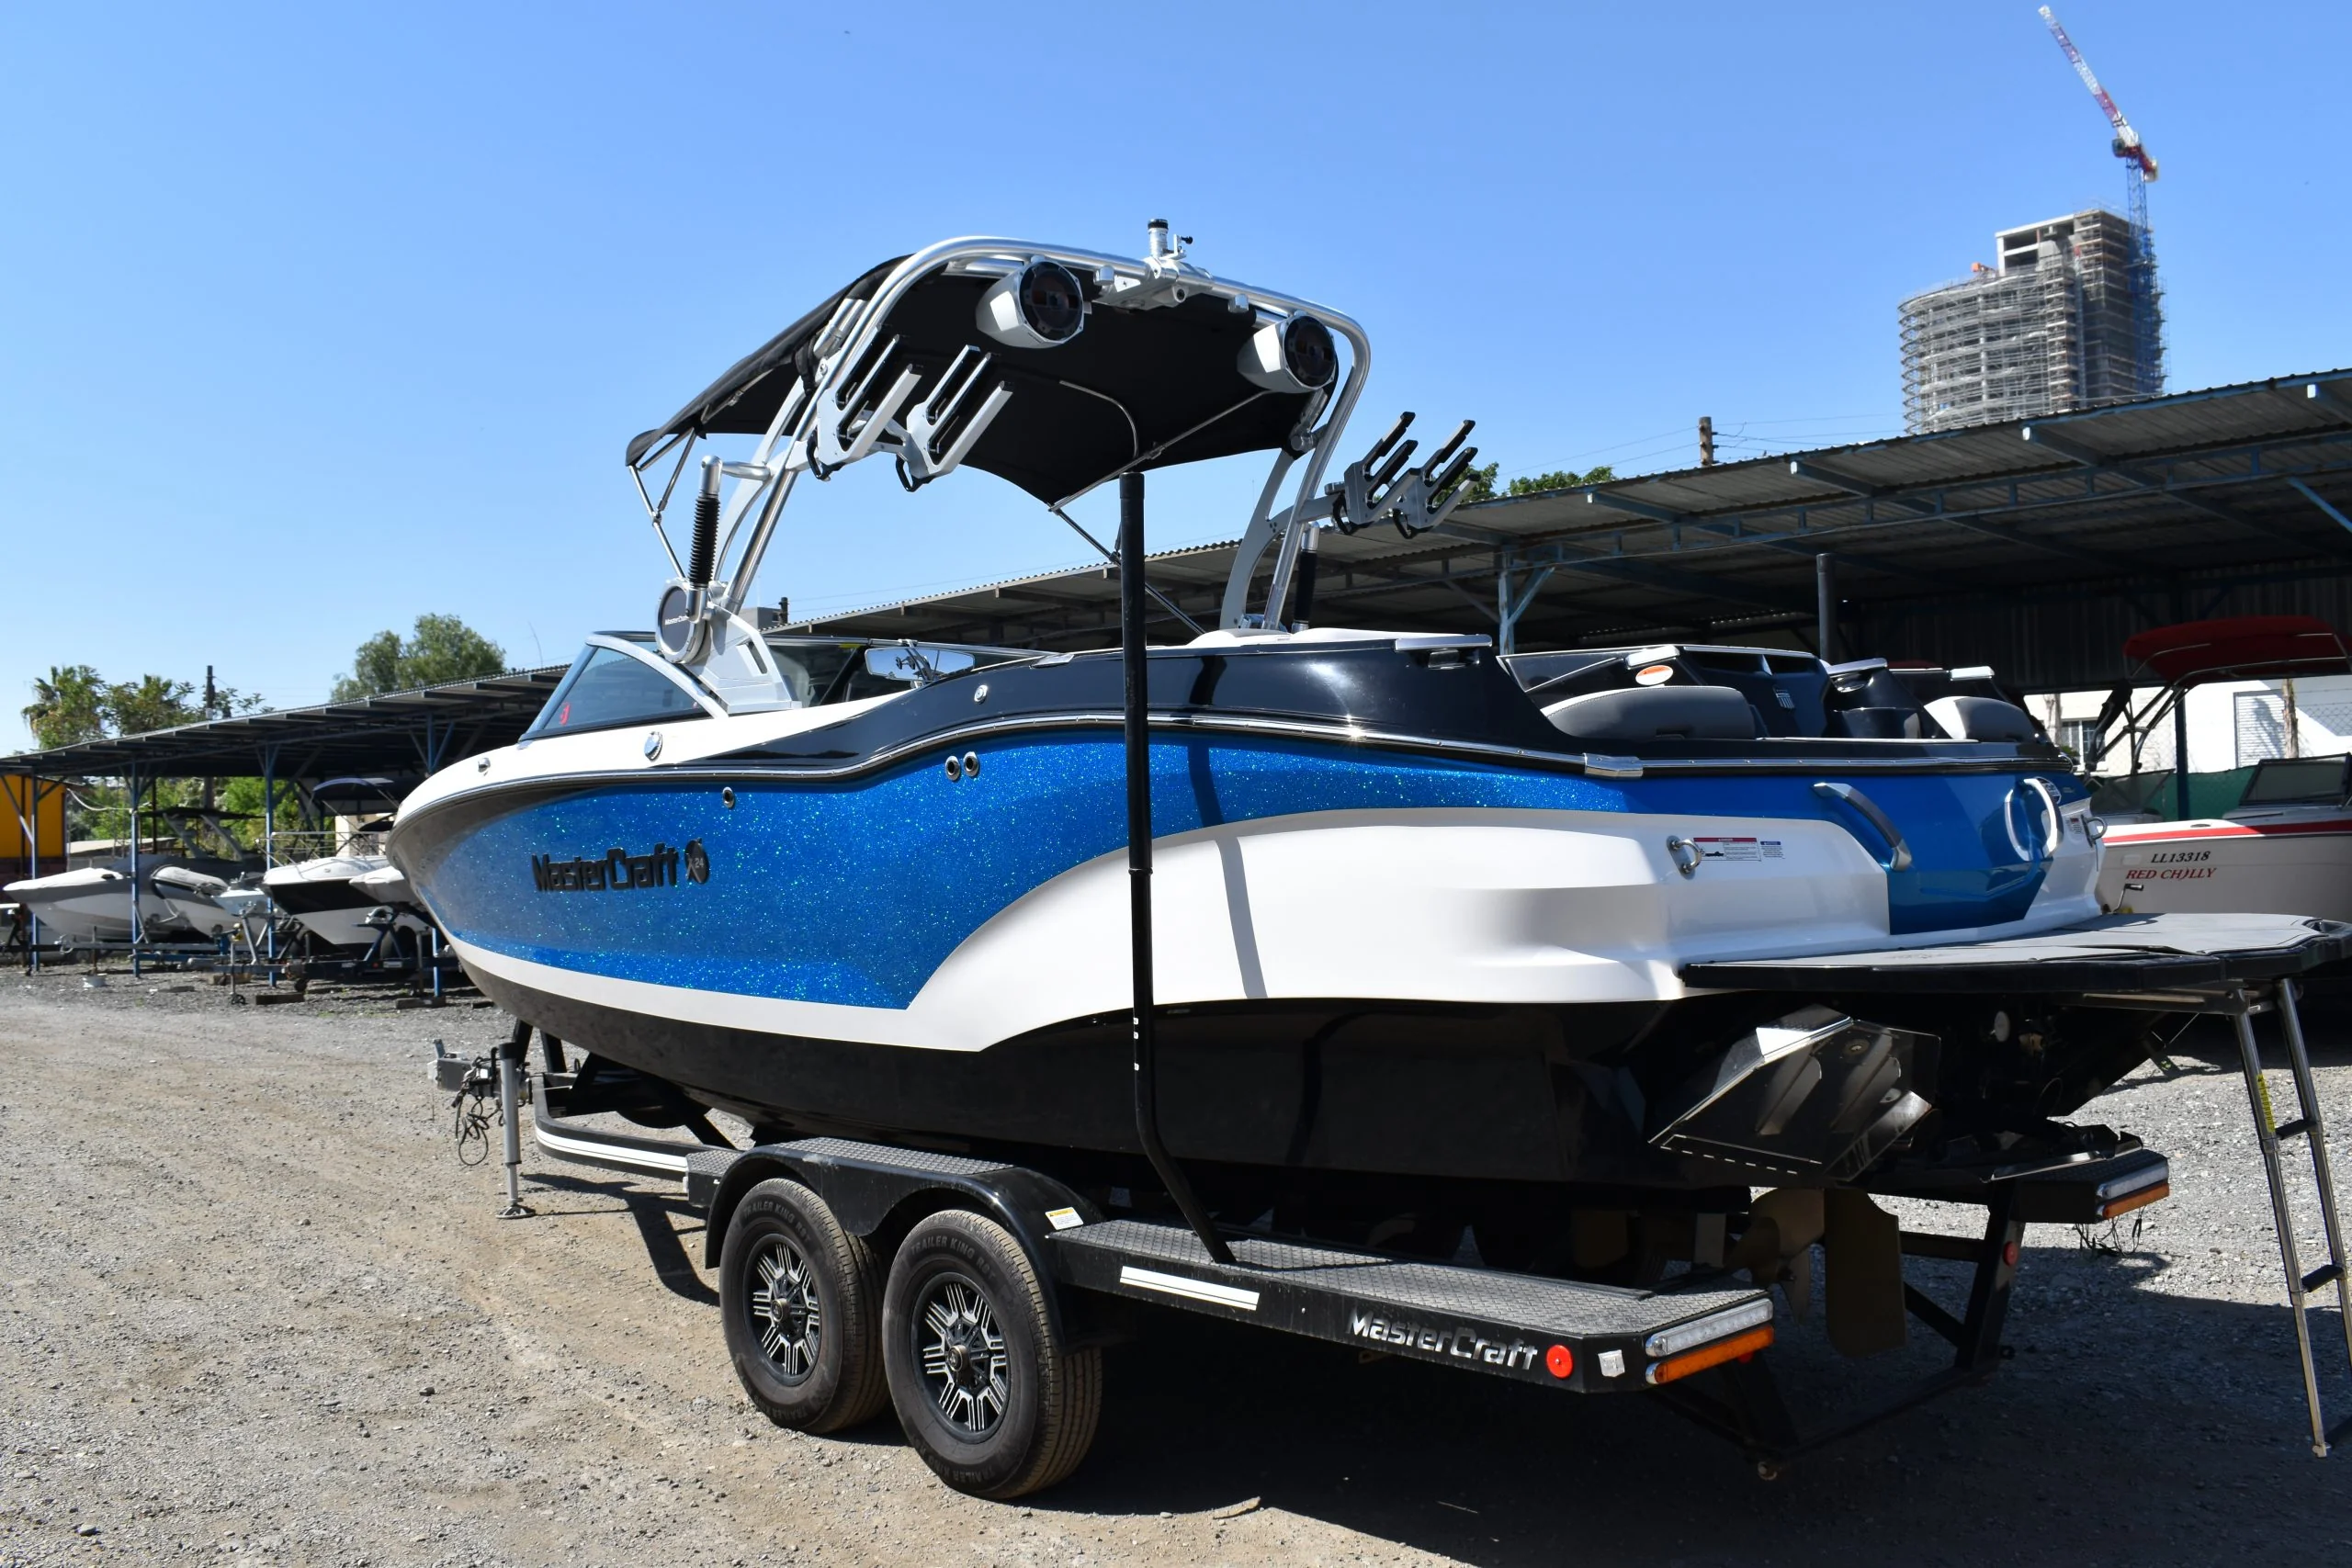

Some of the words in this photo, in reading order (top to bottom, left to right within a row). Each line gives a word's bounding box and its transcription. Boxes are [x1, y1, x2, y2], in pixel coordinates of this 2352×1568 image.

[531, 841, 679, 892] MasterCraft
[2150, 851, 2211, 863] LL13318
[2125, 869, 2157, 879] RED
[910, 1235, 948, 1256] TRAILER
[949, 1237, 976, 1259] KING
[1348, 1307, 1538, 1371] MasterCraft
